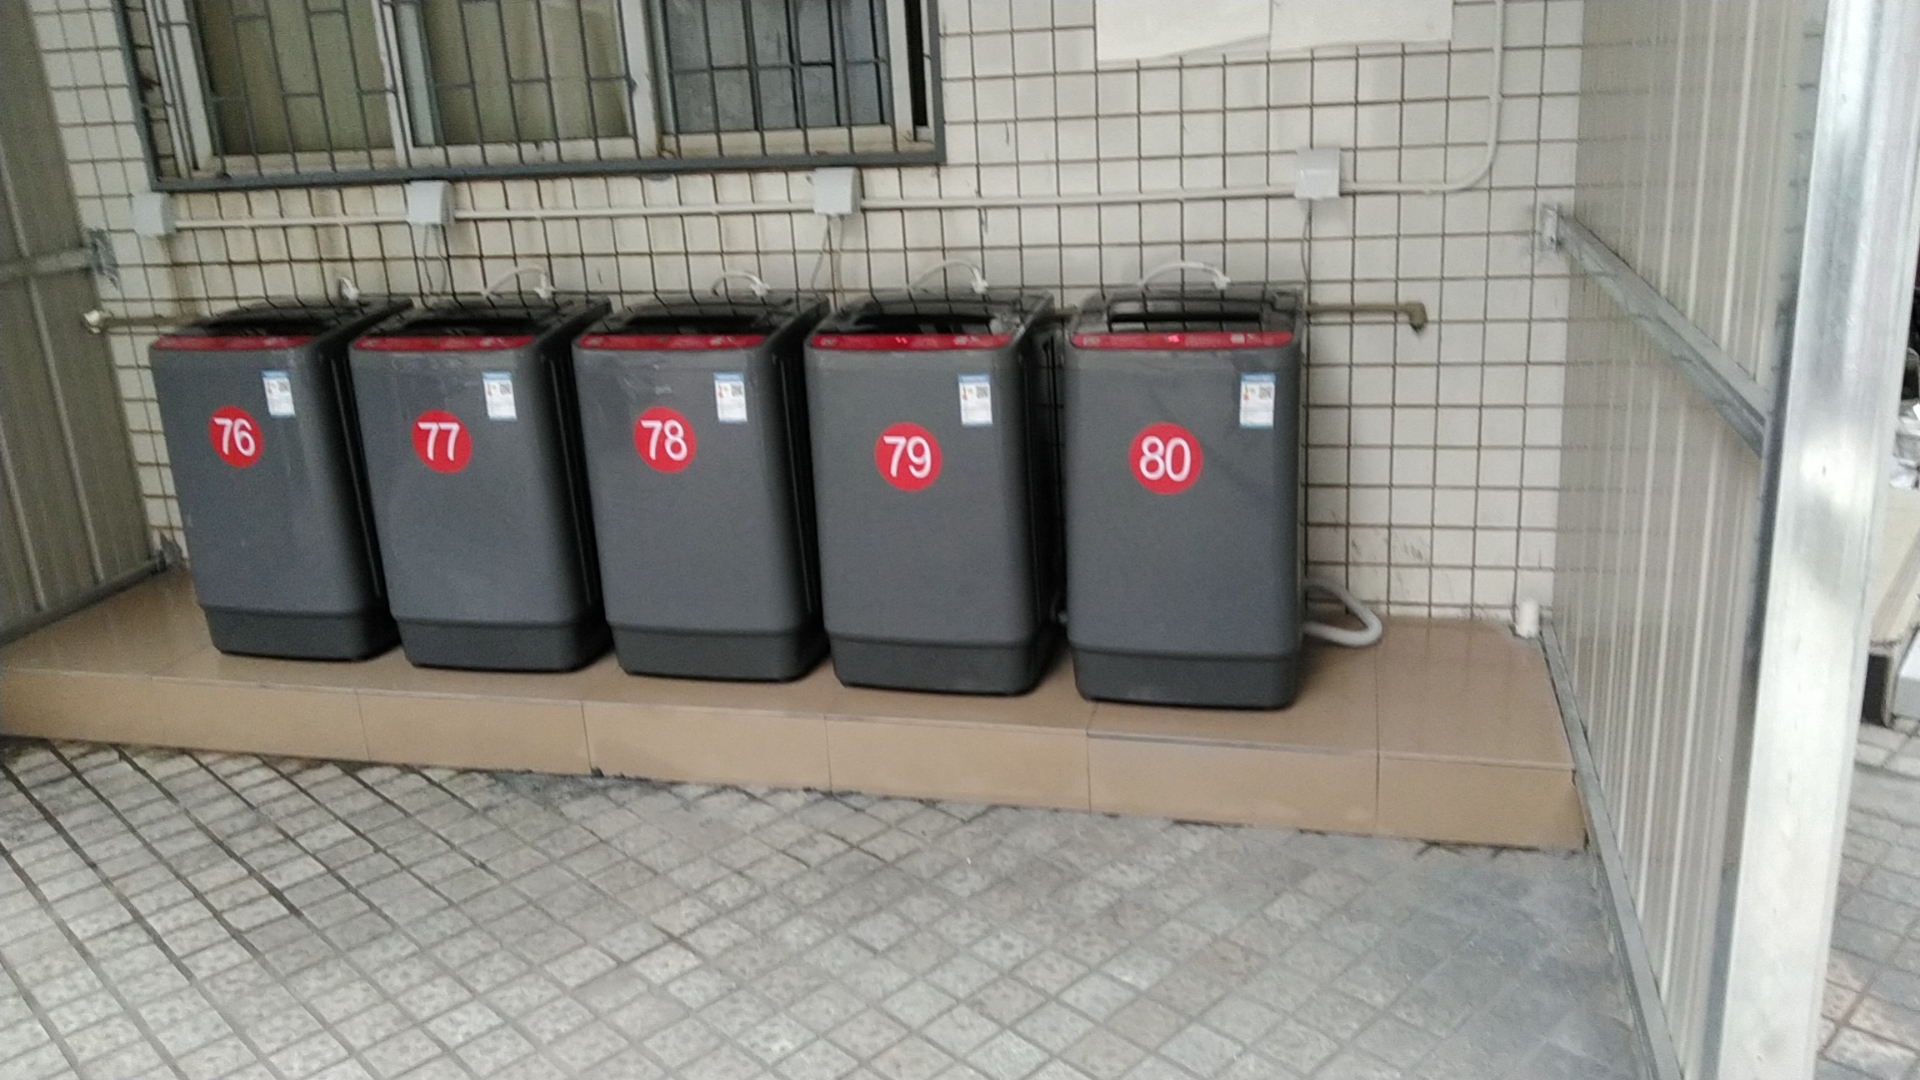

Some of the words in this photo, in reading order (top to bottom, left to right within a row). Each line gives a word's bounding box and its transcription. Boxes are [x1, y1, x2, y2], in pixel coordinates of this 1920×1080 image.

[214, 417, 255, 456] 76
[418, 422, 461, 461] 77
[640, 420, 688, 461] 78
[883, 436, 932, 479] 79
[1140, 436, 1192, 482] 80
